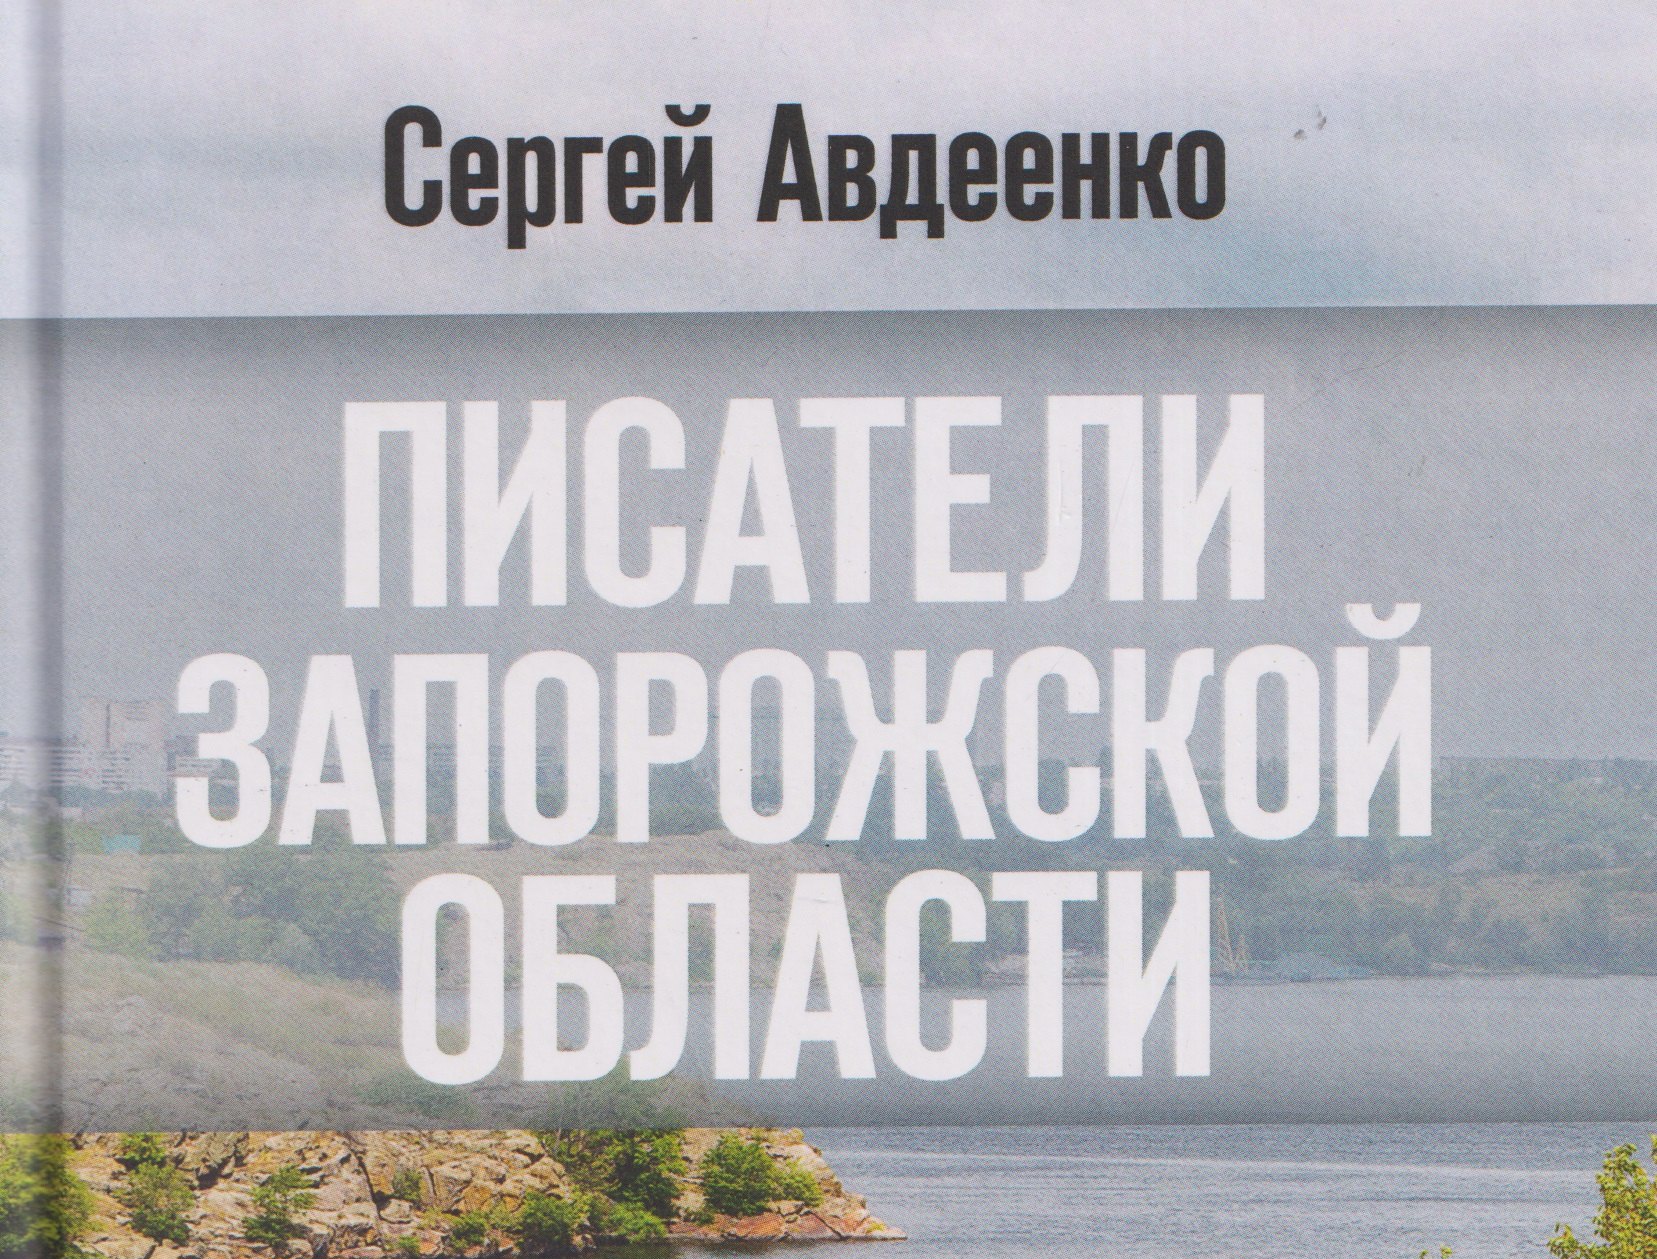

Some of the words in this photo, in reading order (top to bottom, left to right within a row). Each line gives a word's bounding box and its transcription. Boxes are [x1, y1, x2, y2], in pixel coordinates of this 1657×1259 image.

[383, 103, 714, 250] Сергей
[756, 103, 1227, 241] Авдеенко
[343, 394, 1266, 609] ПИСАТЕЛИ
[175, 603, 1433, 849] ЗАПОРОЖСКОЙ
[401, 870, 1212, 1086] ОБЛАСТИ
